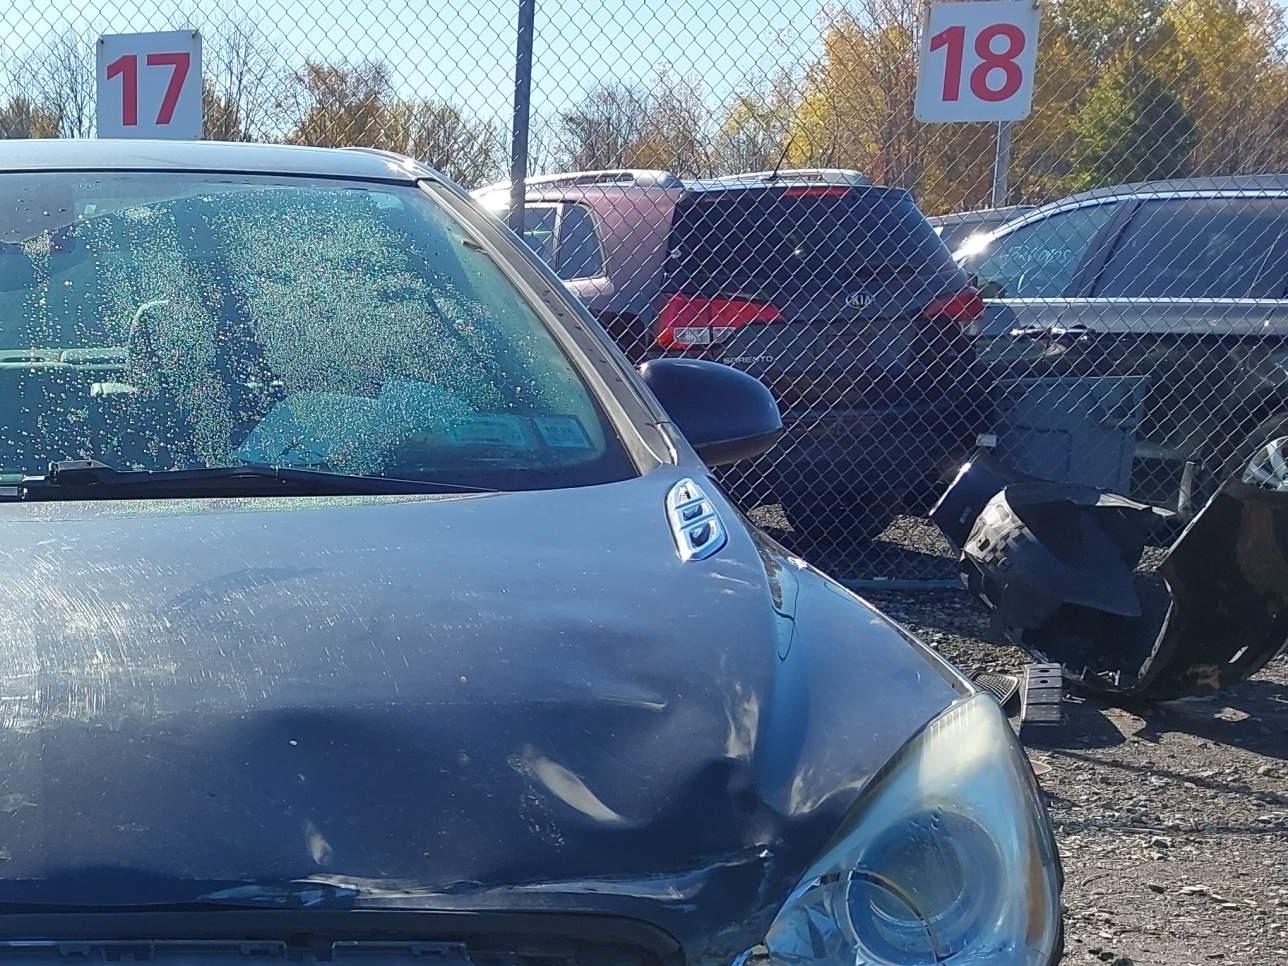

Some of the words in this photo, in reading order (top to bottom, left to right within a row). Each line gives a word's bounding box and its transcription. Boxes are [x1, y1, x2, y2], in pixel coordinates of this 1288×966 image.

[106, 52, 191, 127] 17
[929, 23, 1027, 102] 18
[851, 294, 872, 305] KIA
